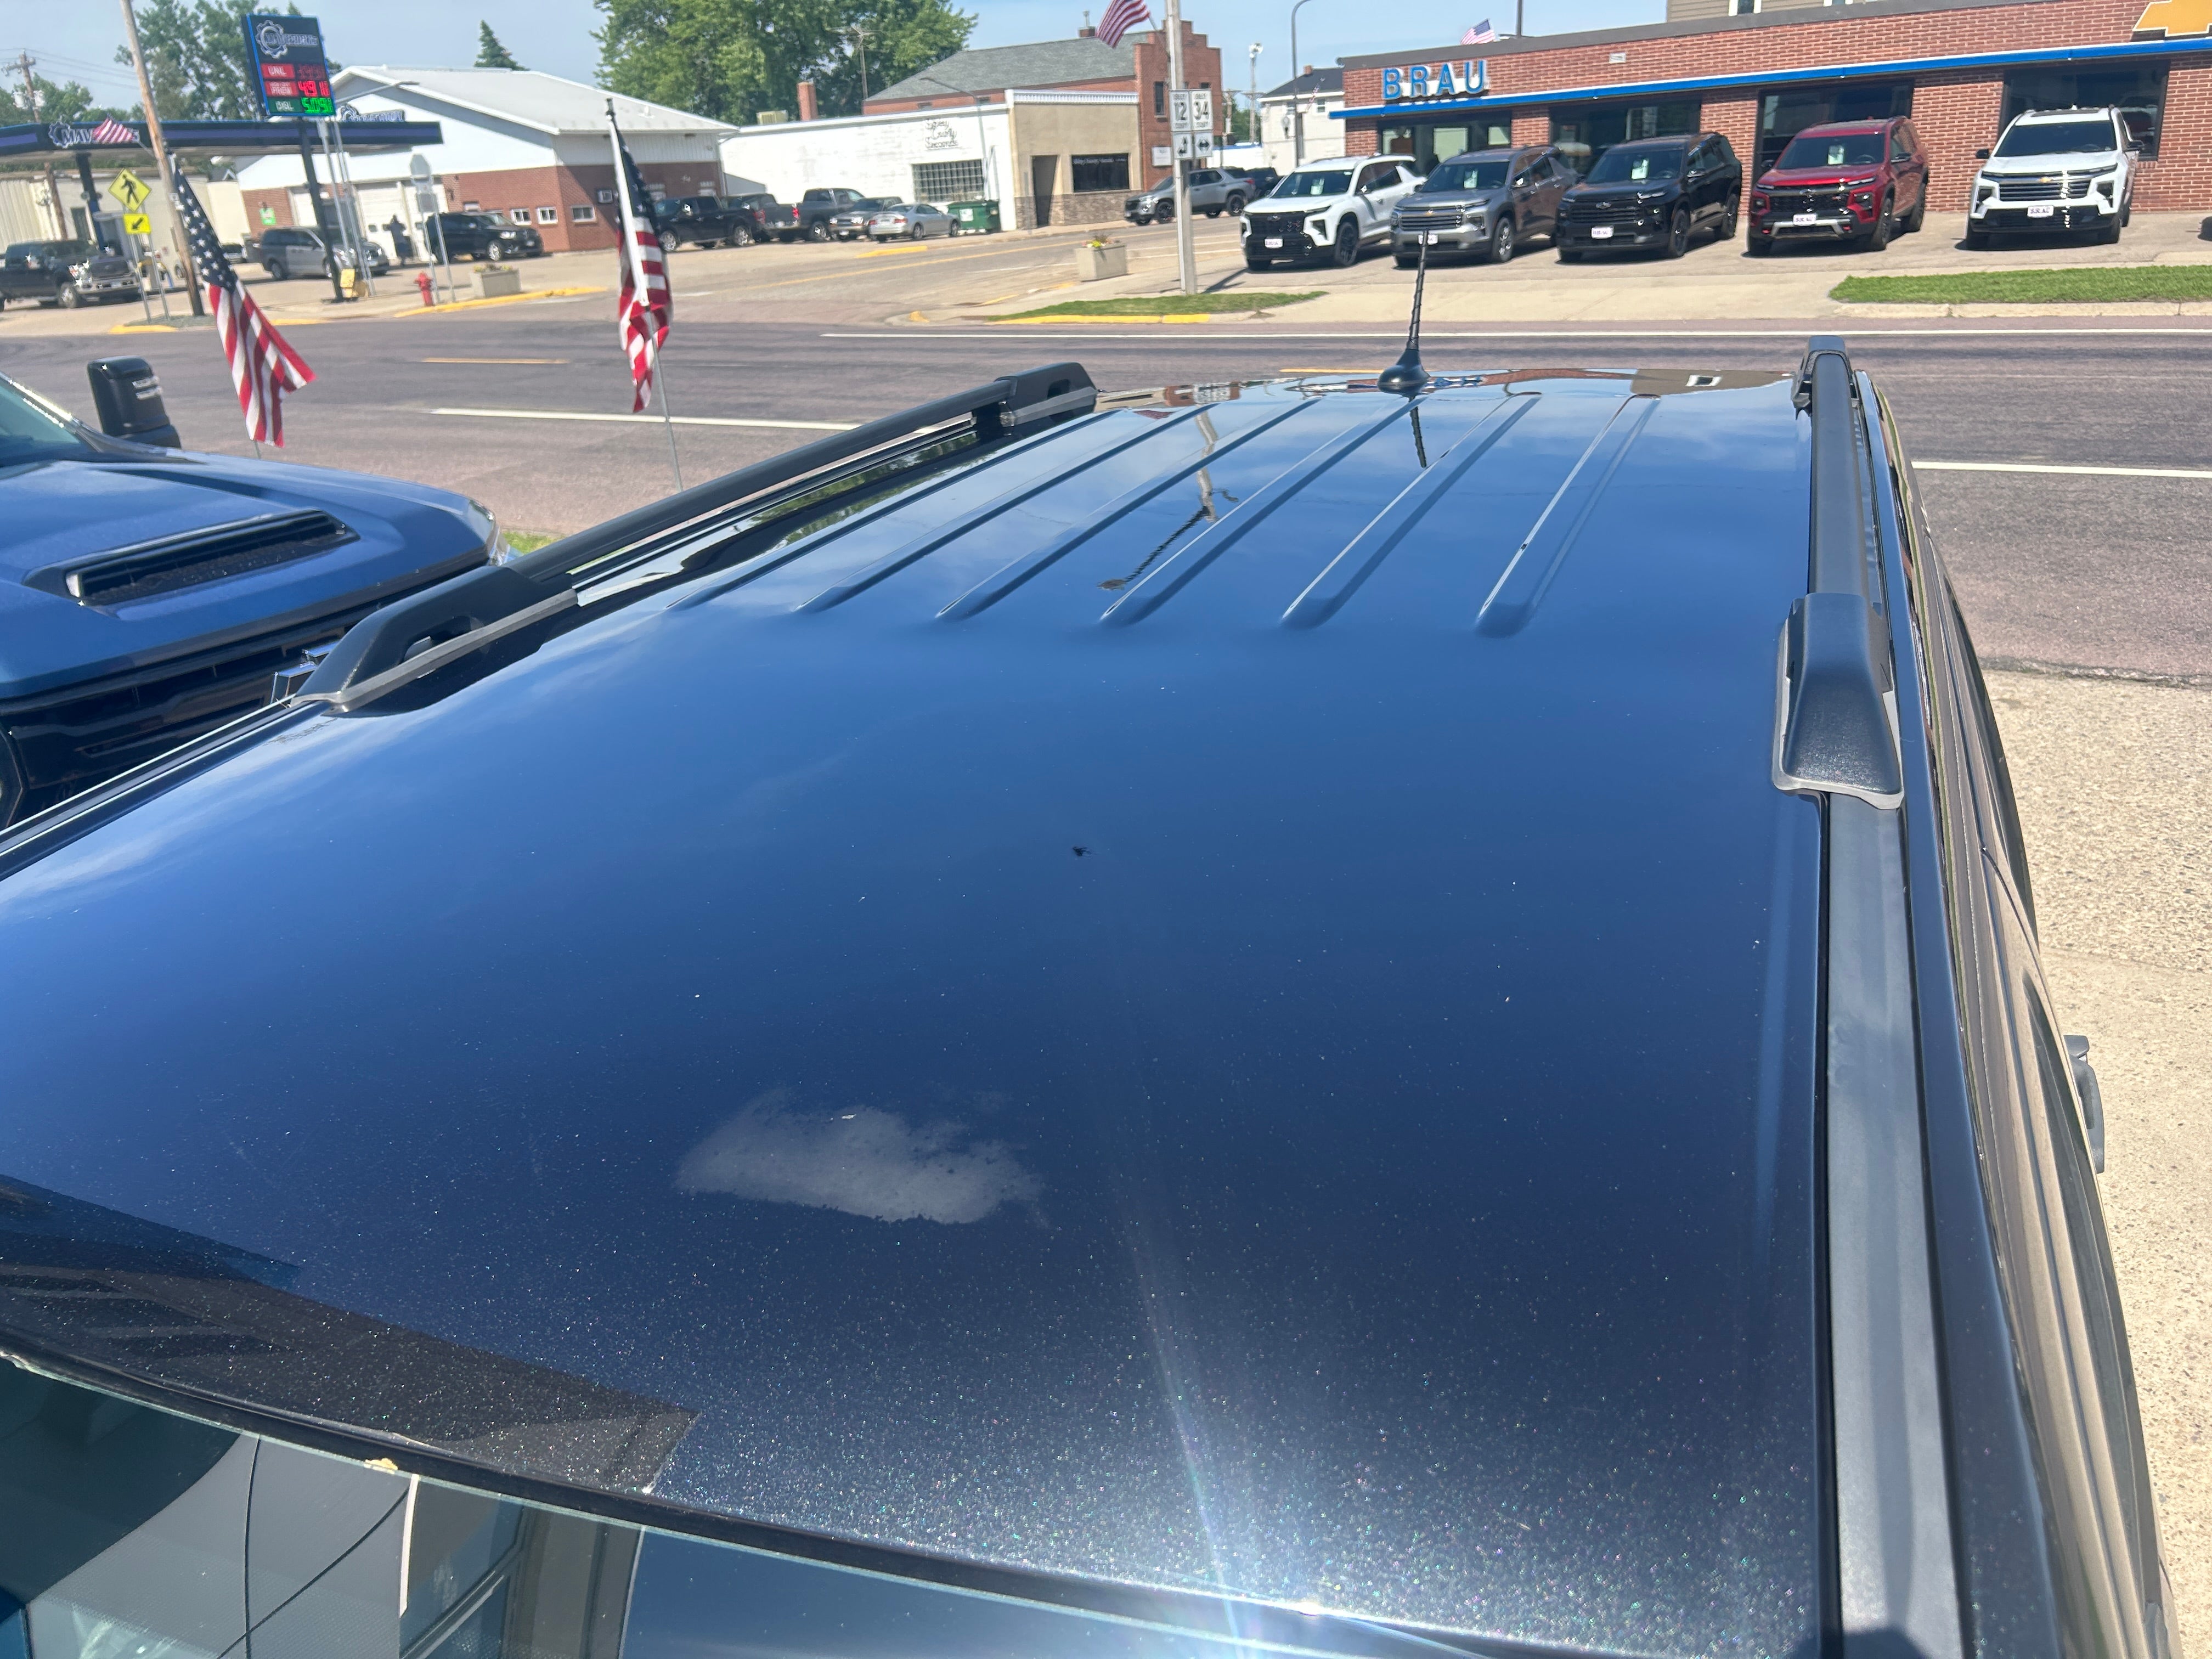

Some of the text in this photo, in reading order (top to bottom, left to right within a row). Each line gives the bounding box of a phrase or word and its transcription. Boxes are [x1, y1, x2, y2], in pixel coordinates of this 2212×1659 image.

[1383, 59, 1485, 100] BRAU
[1173, 101, 1187, 121] 12
[1194, 101, 1210, 120] 34
